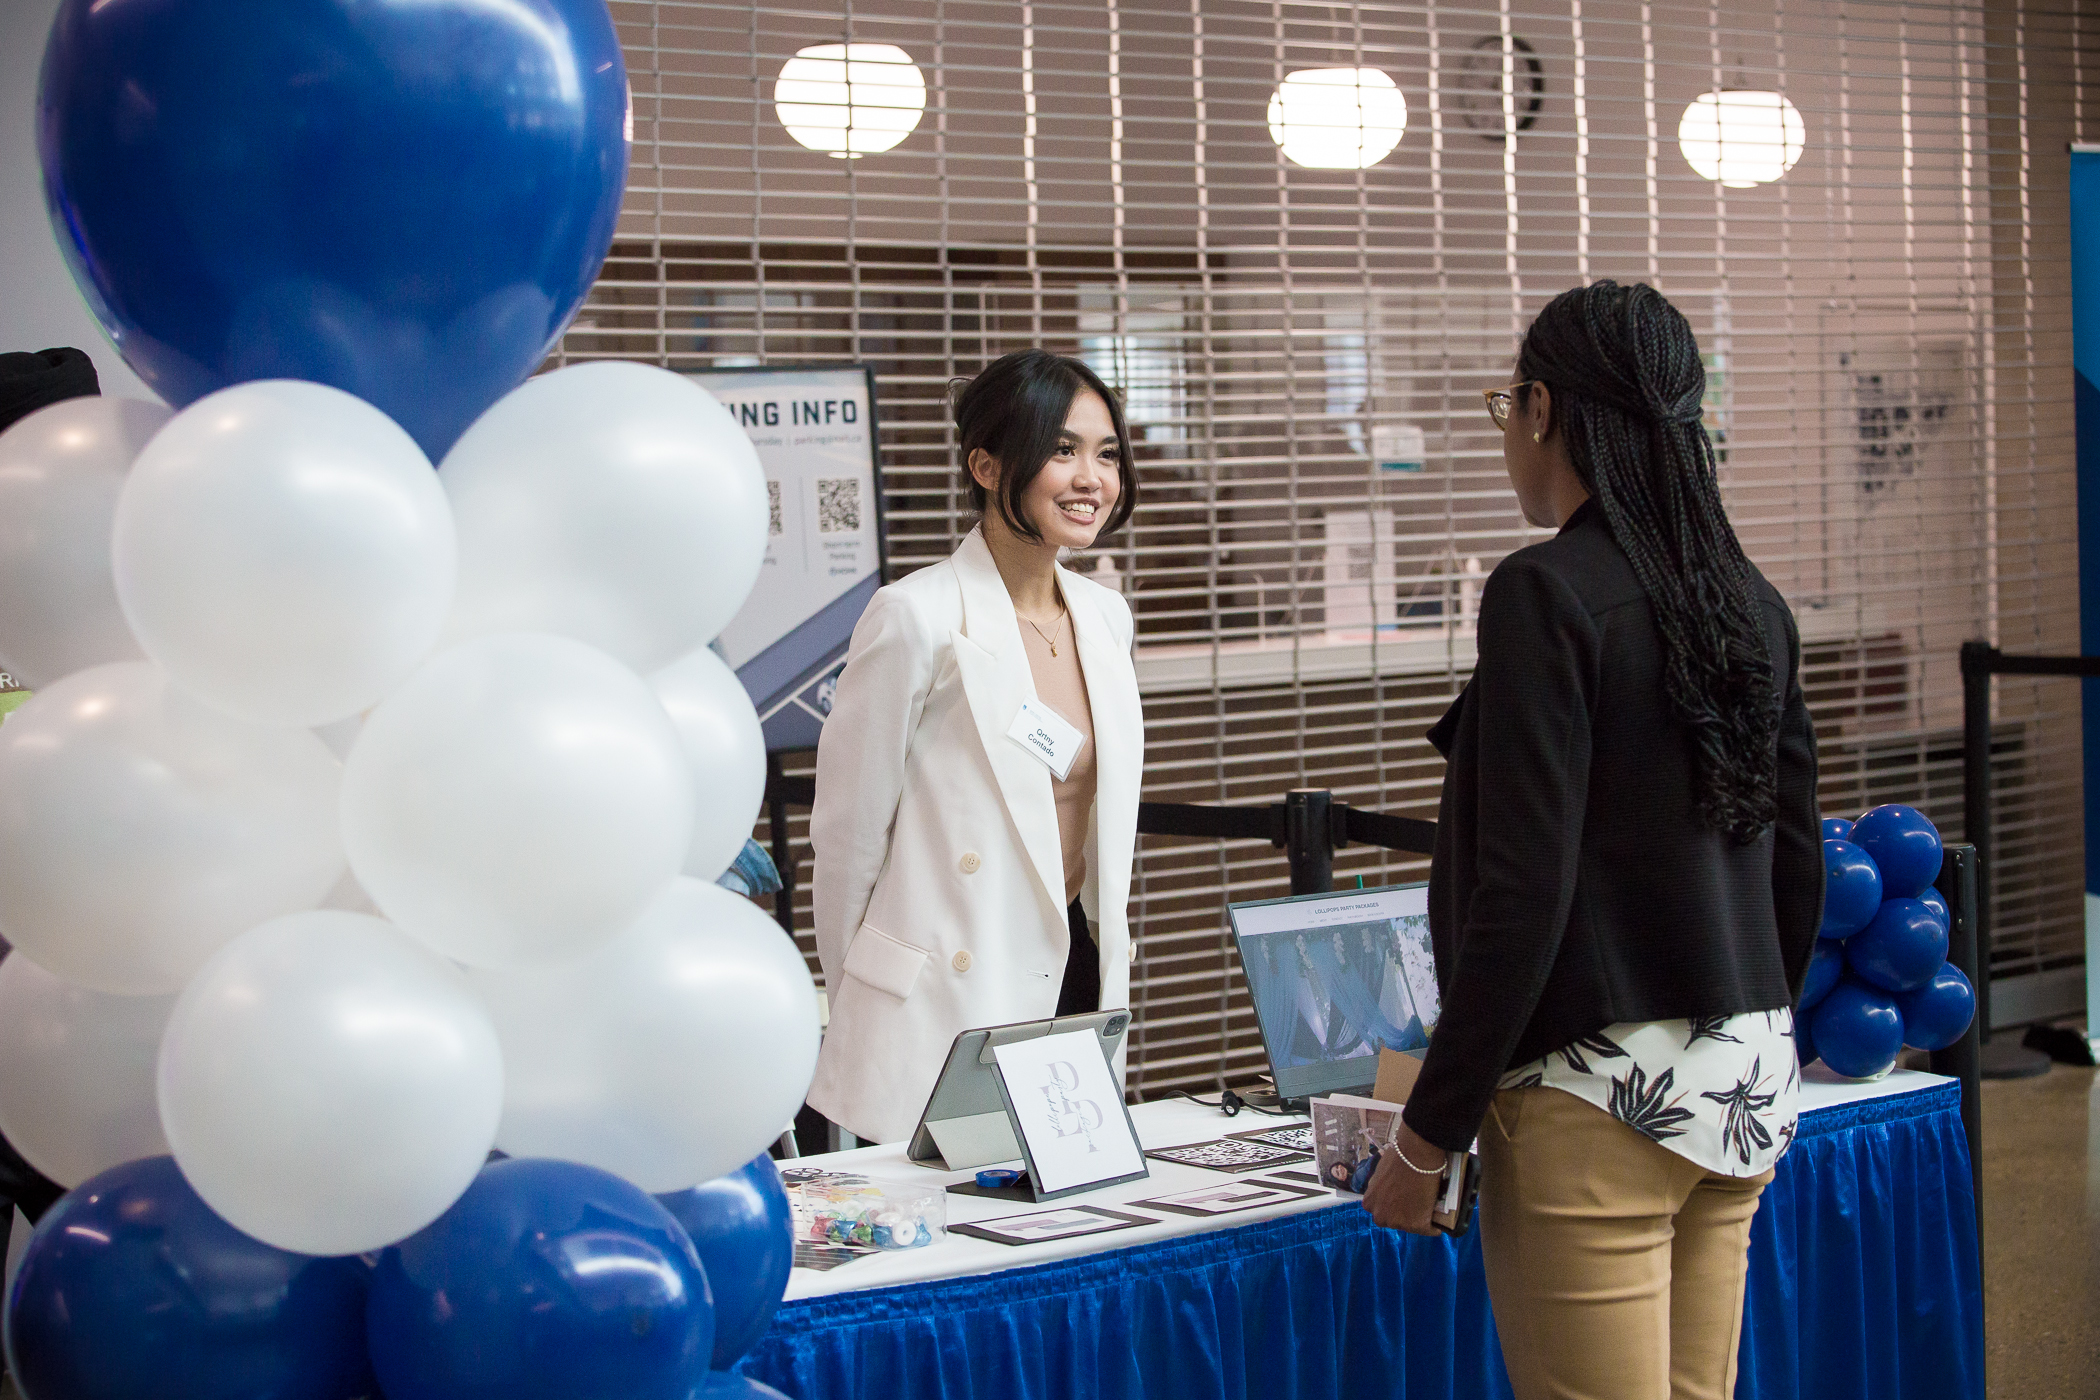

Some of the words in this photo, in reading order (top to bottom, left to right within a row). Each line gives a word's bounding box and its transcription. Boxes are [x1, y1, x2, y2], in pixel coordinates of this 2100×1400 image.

[722, 402, 779, 427] ING
[792, 400, 857, 425] INFO
[1027, 733, 1055, 757] Contado
[1036, 728, 1055, 746] Qrtny
[1314, 906, 1339, 914] LOLLIPOPS
